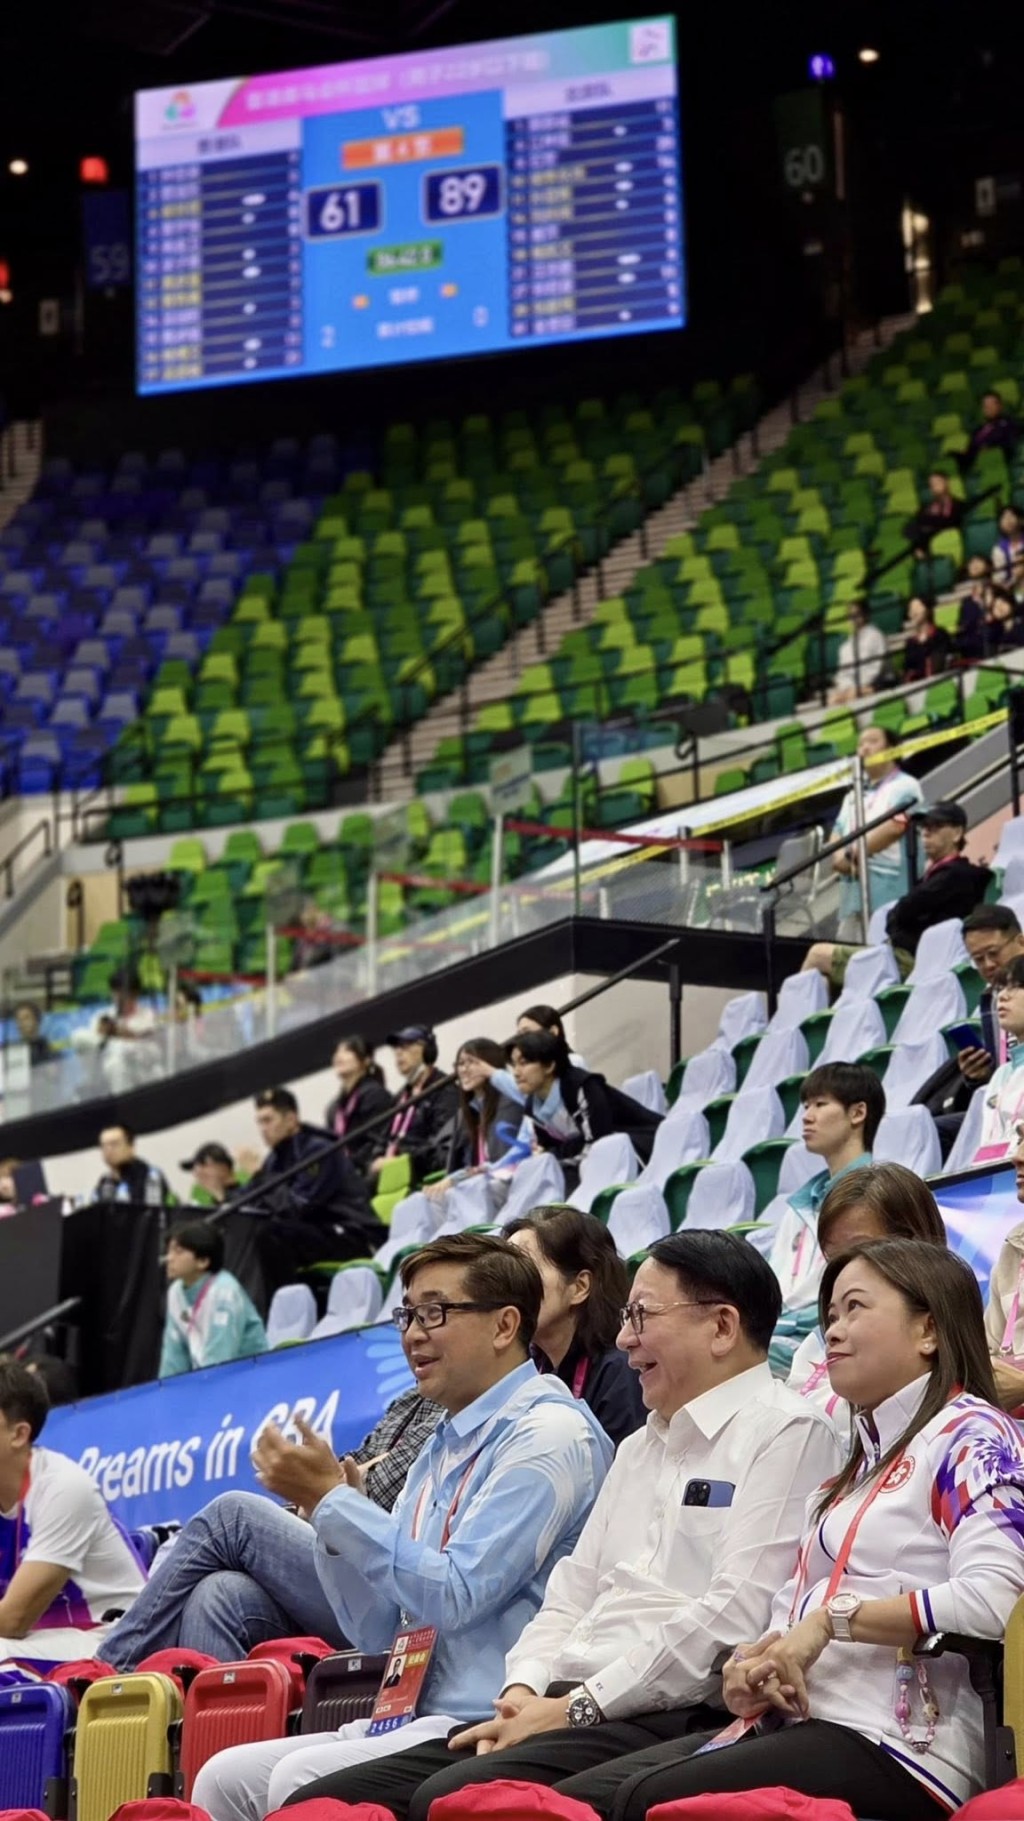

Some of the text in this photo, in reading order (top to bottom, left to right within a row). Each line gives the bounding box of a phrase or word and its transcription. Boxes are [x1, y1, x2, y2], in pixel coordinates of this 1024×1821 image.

[382, 105, 421, 128] VS
[784, 143, 824, 188] 60
[320, 190, 361, 232] 61
[440, 173, 487, 216] 89
[204, 1413, 246, 1482] in
